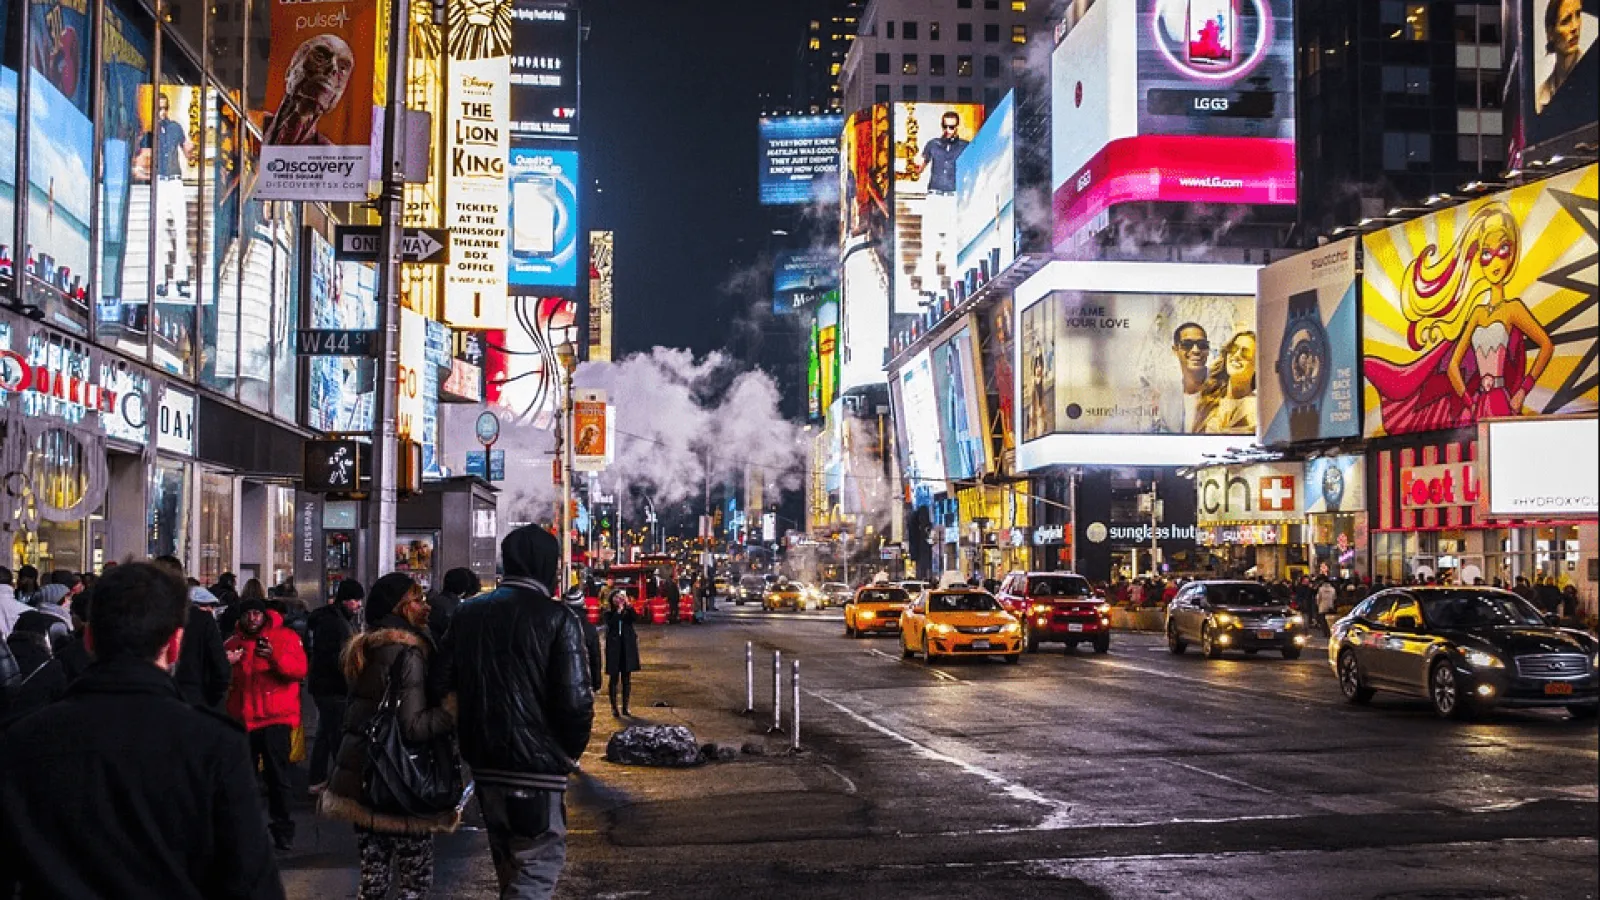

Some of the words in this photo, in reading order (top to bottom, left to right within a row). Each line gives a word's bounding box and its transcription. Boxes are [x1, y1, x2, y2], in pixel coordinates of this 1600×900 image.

[461, 101, 492, 117] THE
[1195, 98, 1209, 109] LG
[1211, 98, 1228, 110] G3
[456, 119, 498, 145] LION
[453, 147, 504, 177] KING
[456, 203, 498, 213] TICKETS
[459, 215, 471, 223] AT
[476, 216, 495, 224] THE
[449, 226, 505, 236] MINSKOFF
[453, 238, 500, 248] THEATRE
[464, 251, 488, 259] BOX
[458, 263, 494, 271] OFFICE
[1066, 318, 1096, 329] YOUR
[1100, 318, 1130, 329] LOVE
[302, 333, 321, 352] W
[324, 333, 350, 352] 44
[36, 366, 118, 414] OAKLEY
[1402, 469, 1454, 505] Foot
[304, 502, 314, 561] Newsstand
[1171, 523, 1195, 539] hut
